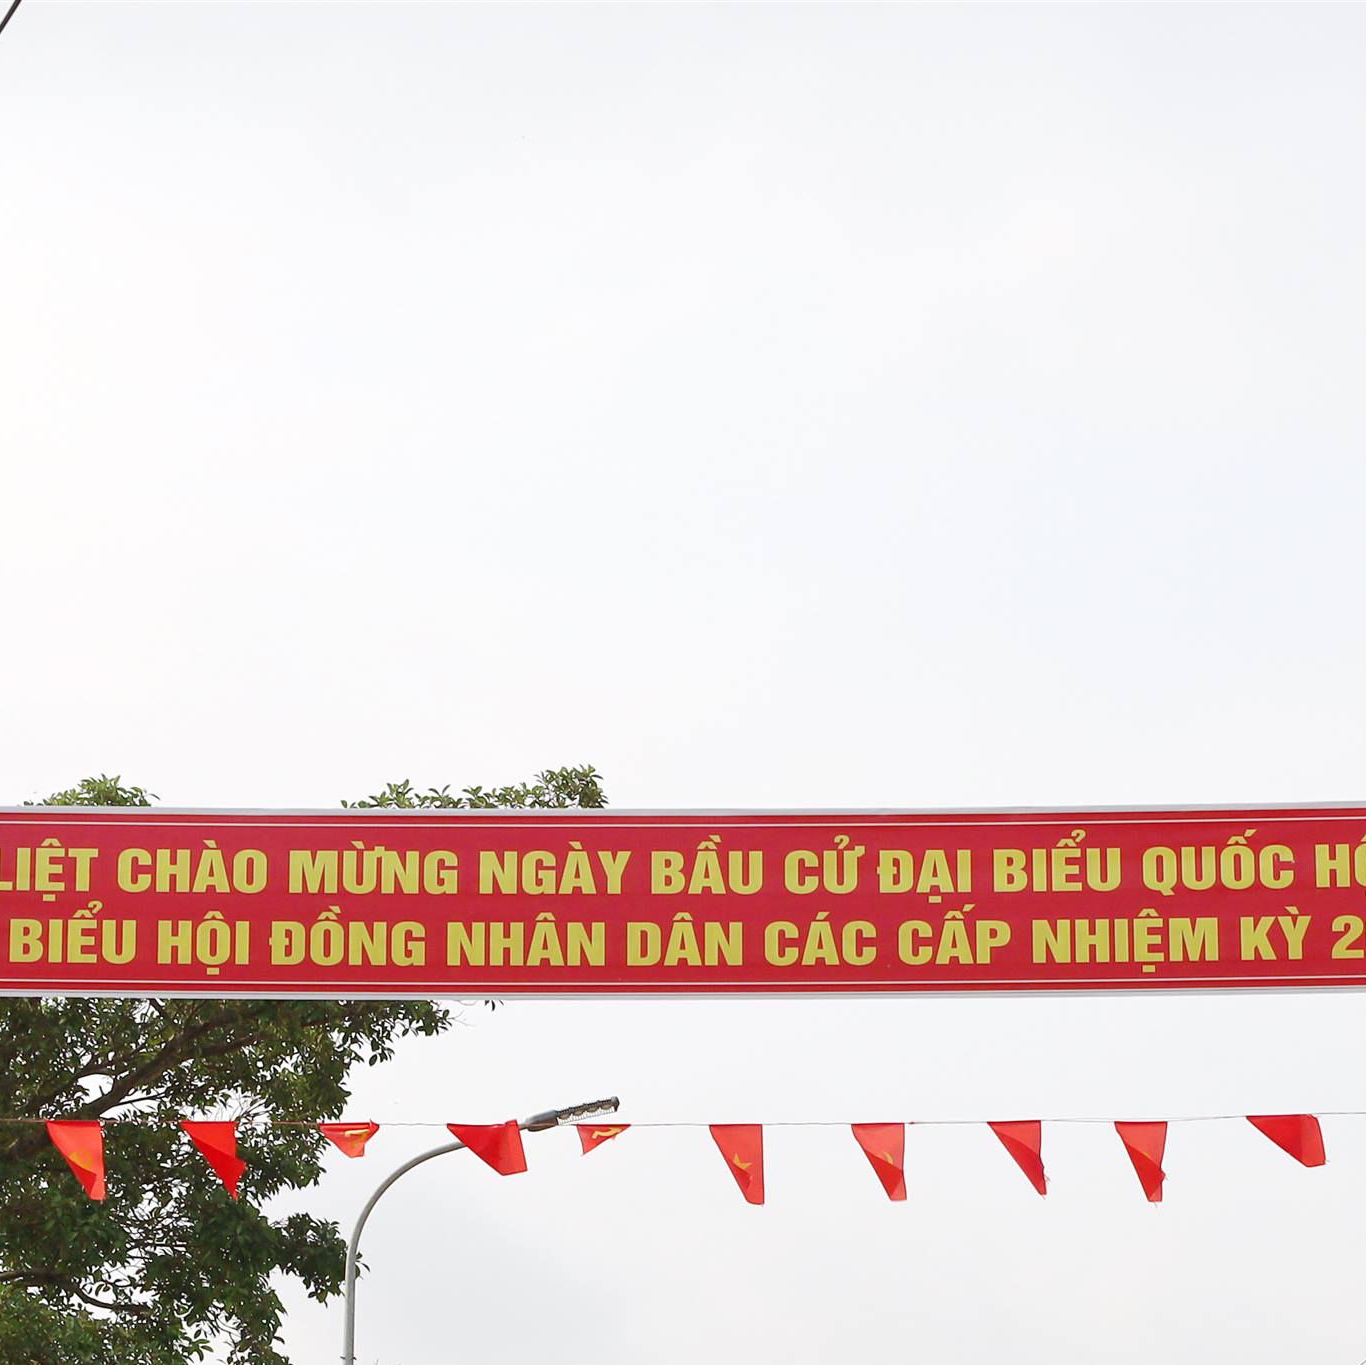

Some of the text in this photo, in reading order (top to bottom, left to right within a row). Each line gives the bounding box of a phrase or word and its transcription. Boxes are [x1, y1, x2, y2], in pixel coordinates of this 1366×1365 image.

[117, 840, 268, 894] CHÀO
[288, 841, 459, 895] MỪNG
[479, 841, 632, 895] NGÀY
[651, 834, 763, 895] BẦU
[784, 834, 866, 894] CỬ
[876, 849, 972, 904] ĐẠI
[993, 829, 1123, 893] BIỂU
[1141, 828, 1296, 897] QUỐC
[8, 900, 137, 965] BIỂU
[156, 911, 251, 976] HỘI
[269, 905, 426, 967] ĐỒNG
[446, 912, 606, 968] NHÂN
[626, 912, 744, 967] DÂN
[763, 911, 877, 967] CÁC
[897, 903, 1012, 966] CẤP
[1031, 908, 1220, 974] NHIỆM
[1239, 906, 1312, 962] KỲ
